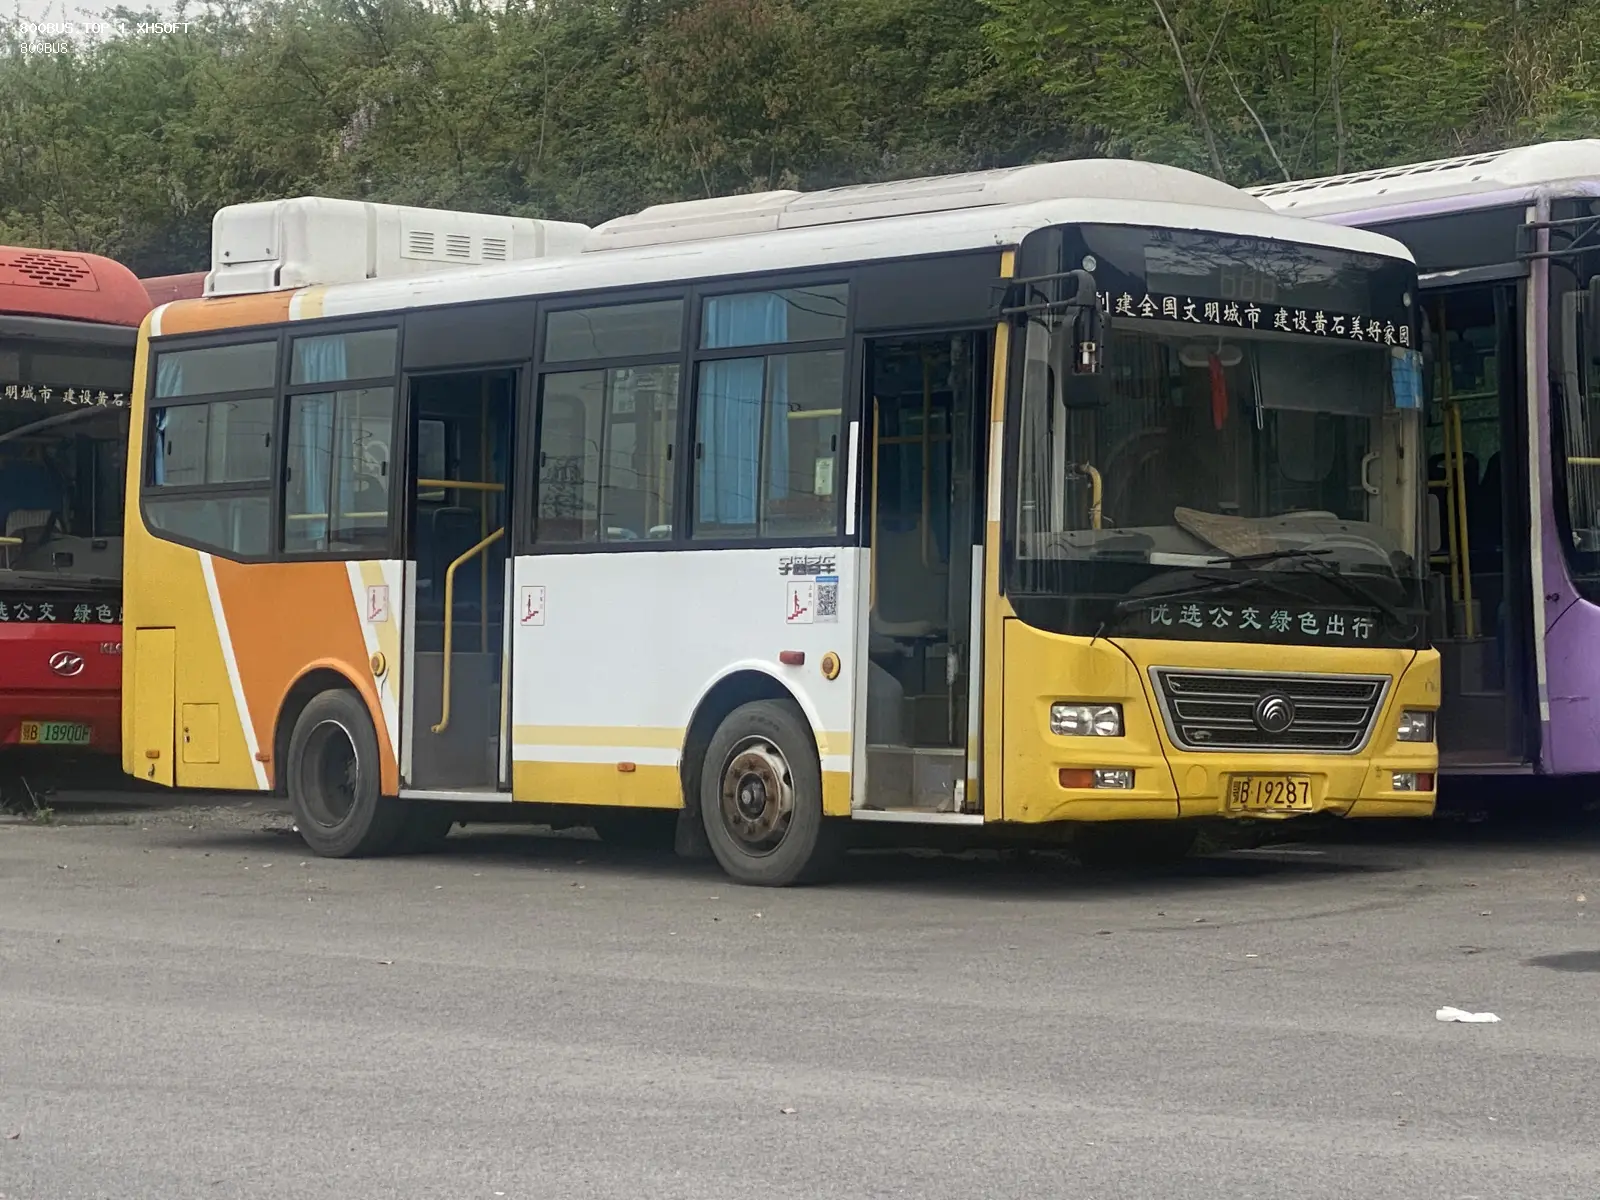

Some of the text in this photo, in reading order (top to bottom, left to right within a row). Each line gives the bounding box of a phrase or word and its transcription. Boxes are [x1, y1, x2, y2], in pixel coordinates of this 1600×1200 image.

[1274, 309, 1410, 347] 建设黄石美好家园
[0, 384, 133, 409] 明城市 建设黄石
[73, 603, 123, 624] 绿色
[1150, 603, 1374, 639] 优选公交绿色出行
